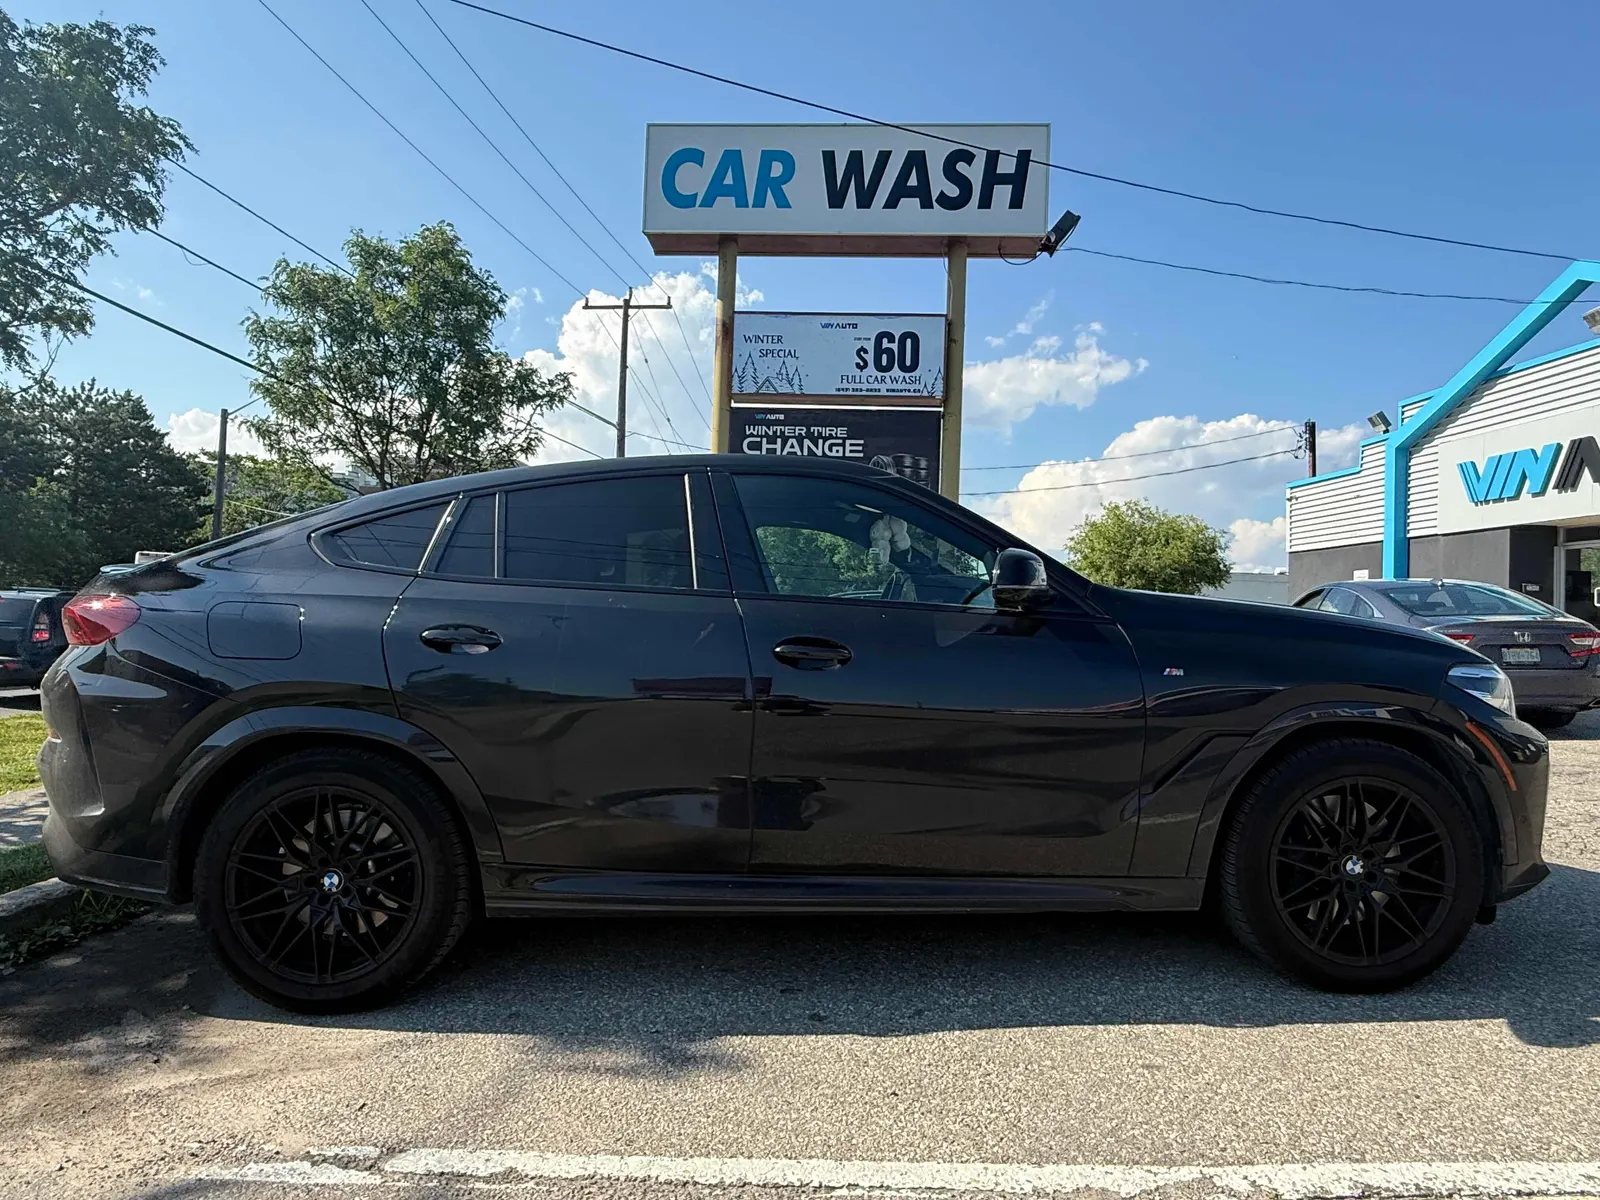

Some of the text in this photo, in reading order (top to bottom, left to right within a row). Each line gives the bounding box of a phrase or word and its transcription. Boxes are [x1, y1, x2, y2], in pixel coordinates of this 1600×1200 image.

[661, 147, 1032, 211] CAR WASH
[743, 334, 784, 344] WINTER
[759, 348, 799, 360] SPECIAL
[855, 330, 920, 374] $60
[840, 374, 922, 385] FULL CAR WASH
[745, 425, 848, 438] WINTER TIRE
[742, 437, 864, 457] CHANGE
